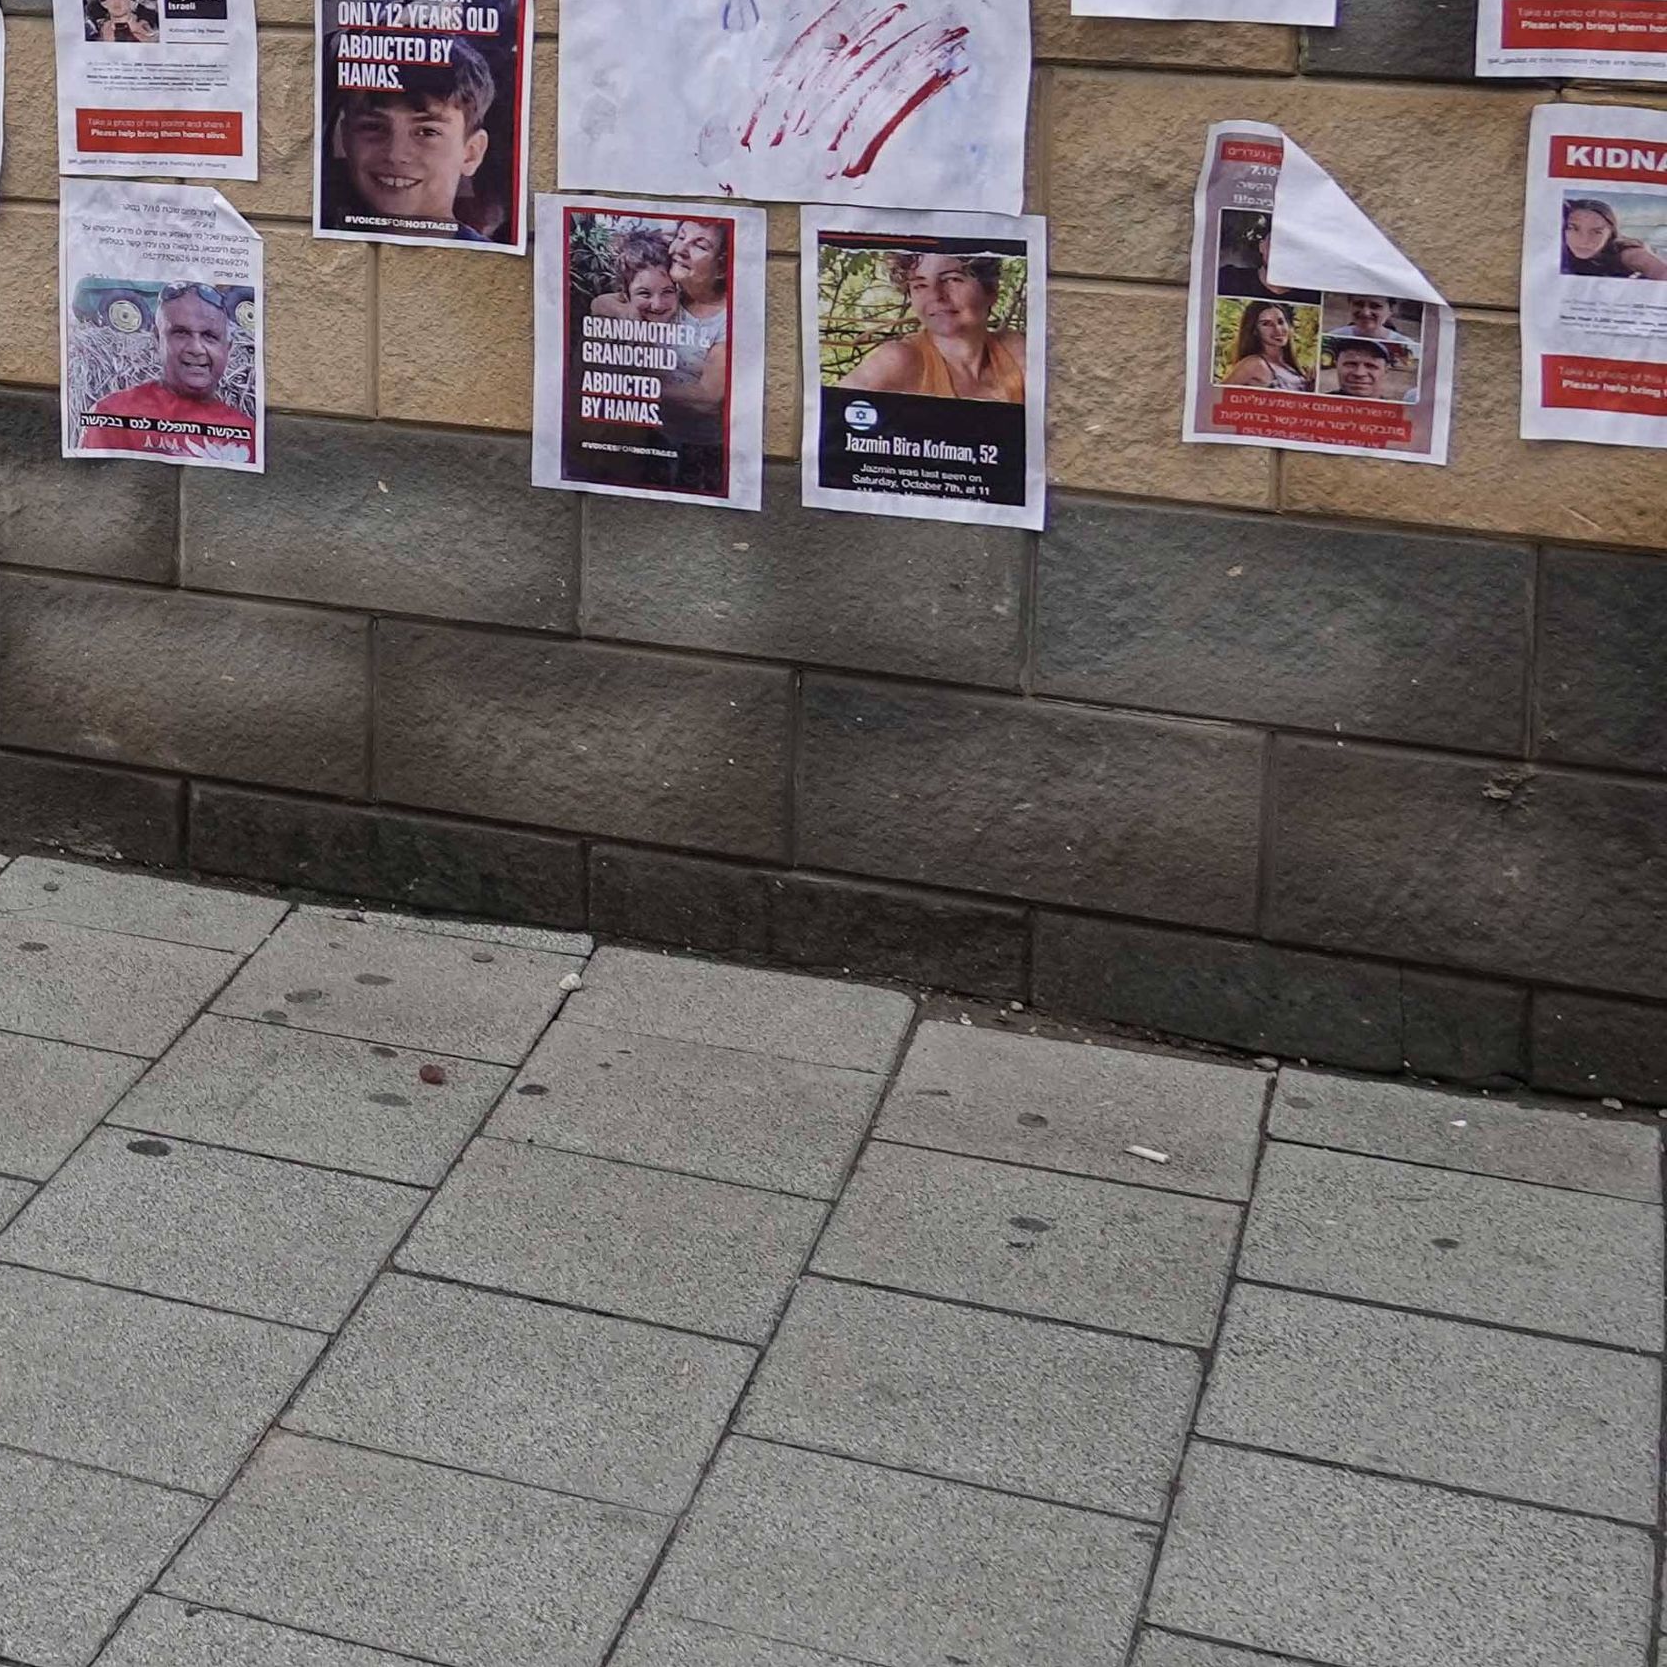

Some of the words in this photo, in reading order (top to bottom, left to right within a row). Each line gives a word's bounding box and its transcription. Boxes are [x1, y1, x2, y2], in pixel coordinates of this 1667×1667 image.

[167, 2, 196, 10] Israeli
[338, 3, 383, 26] ONLY
[386, 4, 404, 27] 12
[407, 5, 462, 30] YEARS
[466, 7, 499, 32] OLD
[338, 34, 426, 61] ABDUCTED
[430, 38, 452, 63] BY
[338, 63, 403, 88] HAMAS.
[344, 215, 458, 231] #VOICESFORHOSTAGES
[582, 317, 696, 347] GRANDMOTHER
[582, 342, 678, 369] GRANDCHILD
[582, 374, 661, 398] ABDUCTED
[80, 415, 123, 429] בבקשה
[582, 399, 600, 418] BY
[603, 401, 663, 424] HAMAS.
[129, 419, 151, 429] לנס
[157, 420, 200, 436] תתפללו
[203, 426, 251, 439] בבקשה
[844, 432, 890, 454] Jazmin
[893, 436, 920, 456] Bira
[923, 439, 976, 463] Kofman,
[979, 444, 998, 464] 52
[859, 463, 895, 474] Jazmin
[897, 468, 919, 477] was
[922, 469, 940, 478] last
[942, 472, 968, 481] seen
[970, 474, 983, 482] on
[901, 478, 941, 493] October
[943, 482, 962, 494] 7th,
[965, 485, 977, 494] at
[980, 486, 990, 495] 11
